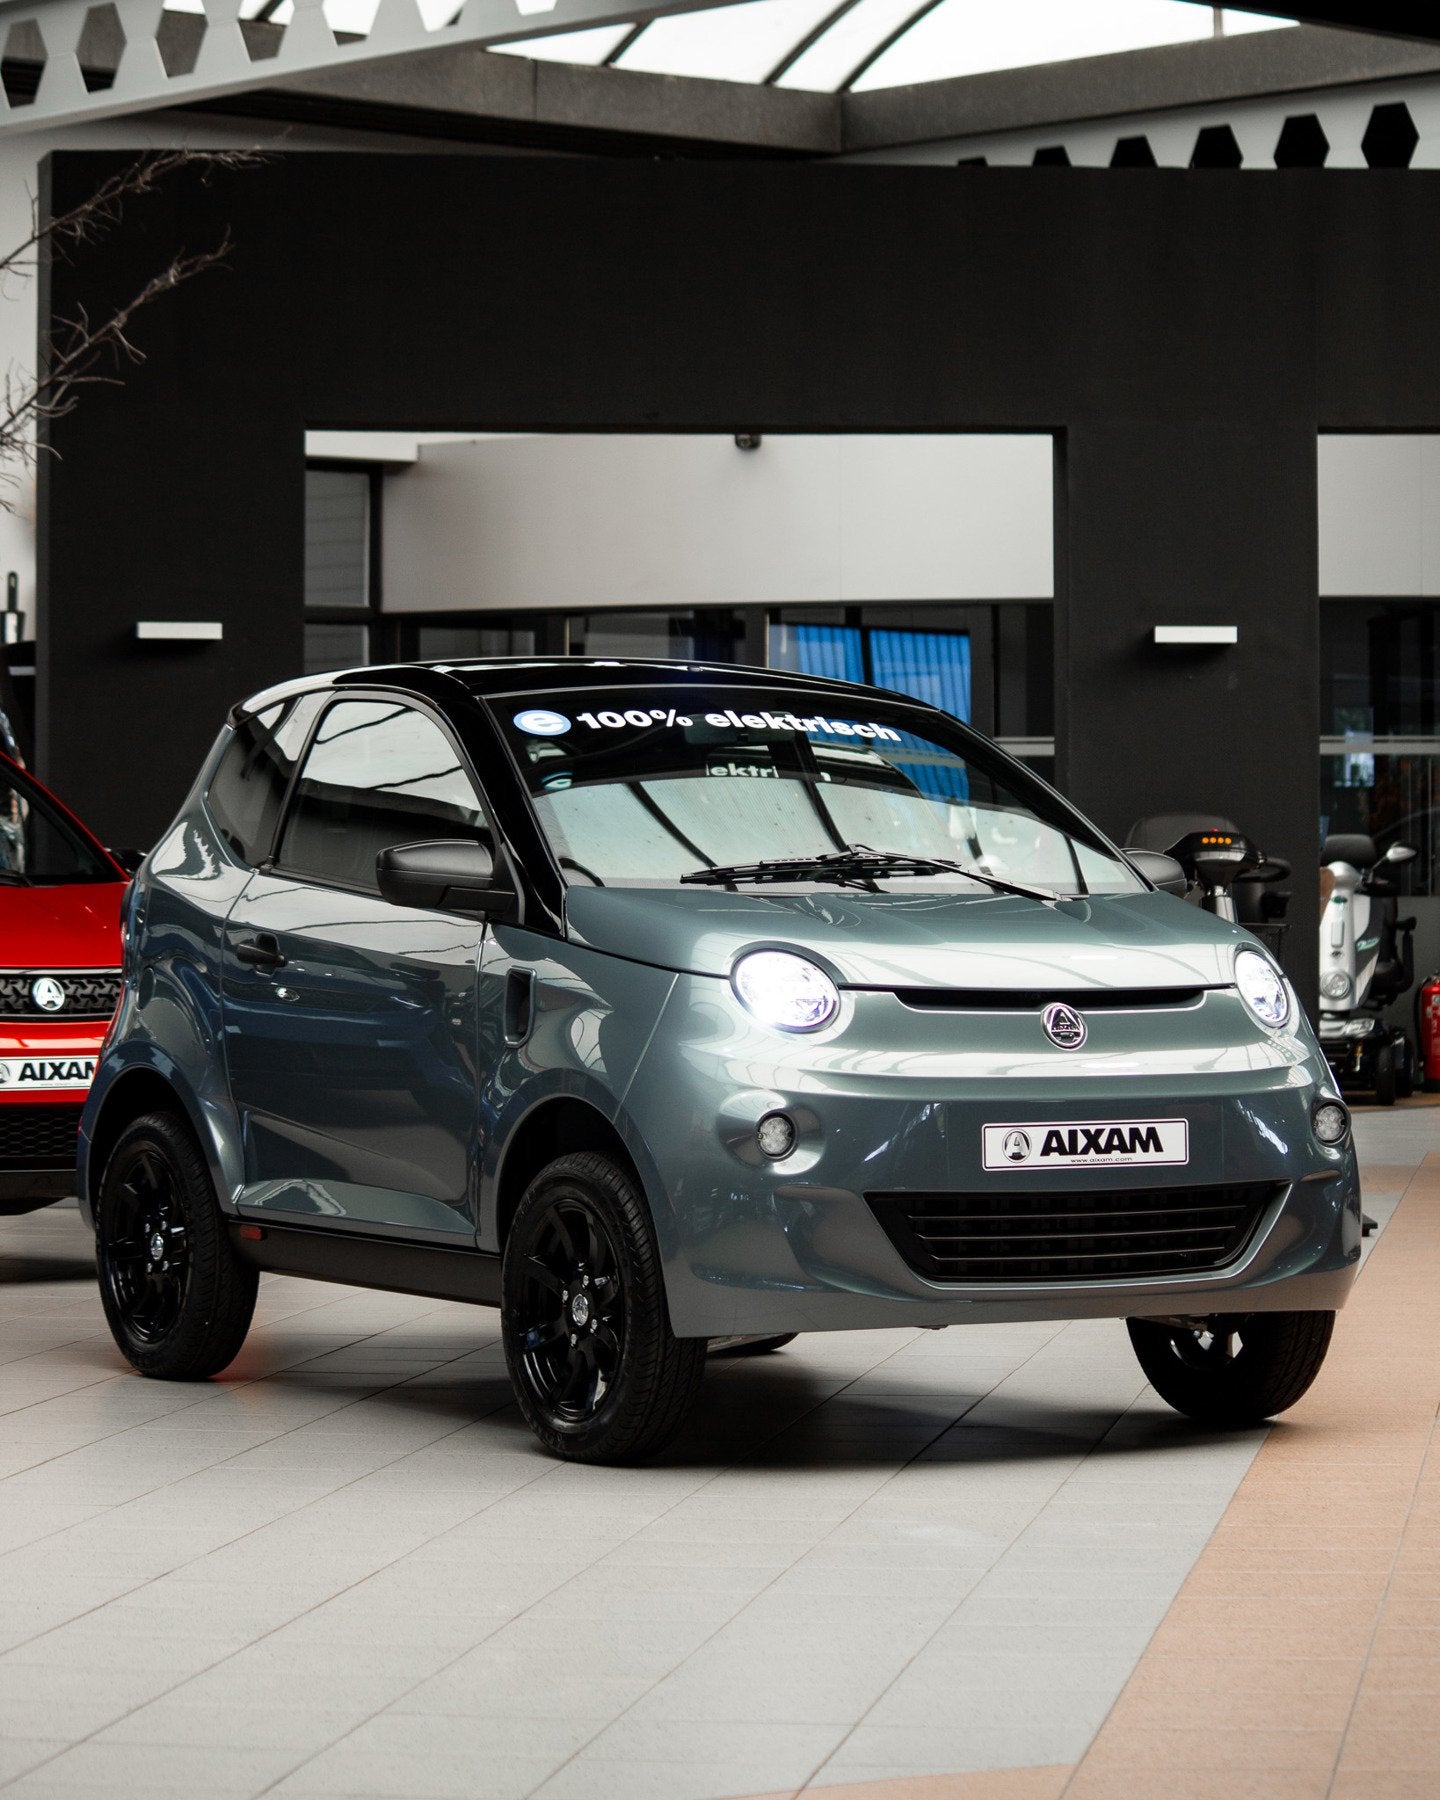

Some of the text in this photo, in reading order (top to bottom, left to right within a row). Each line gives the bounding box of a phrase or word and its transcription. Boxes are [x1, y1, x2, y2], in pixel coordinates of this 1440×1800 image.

[577, 709, 693, 729] 100%
[705, 710, 901, 742] elektrisch
[1040, 1126, 1163, 1157] AIXAM
